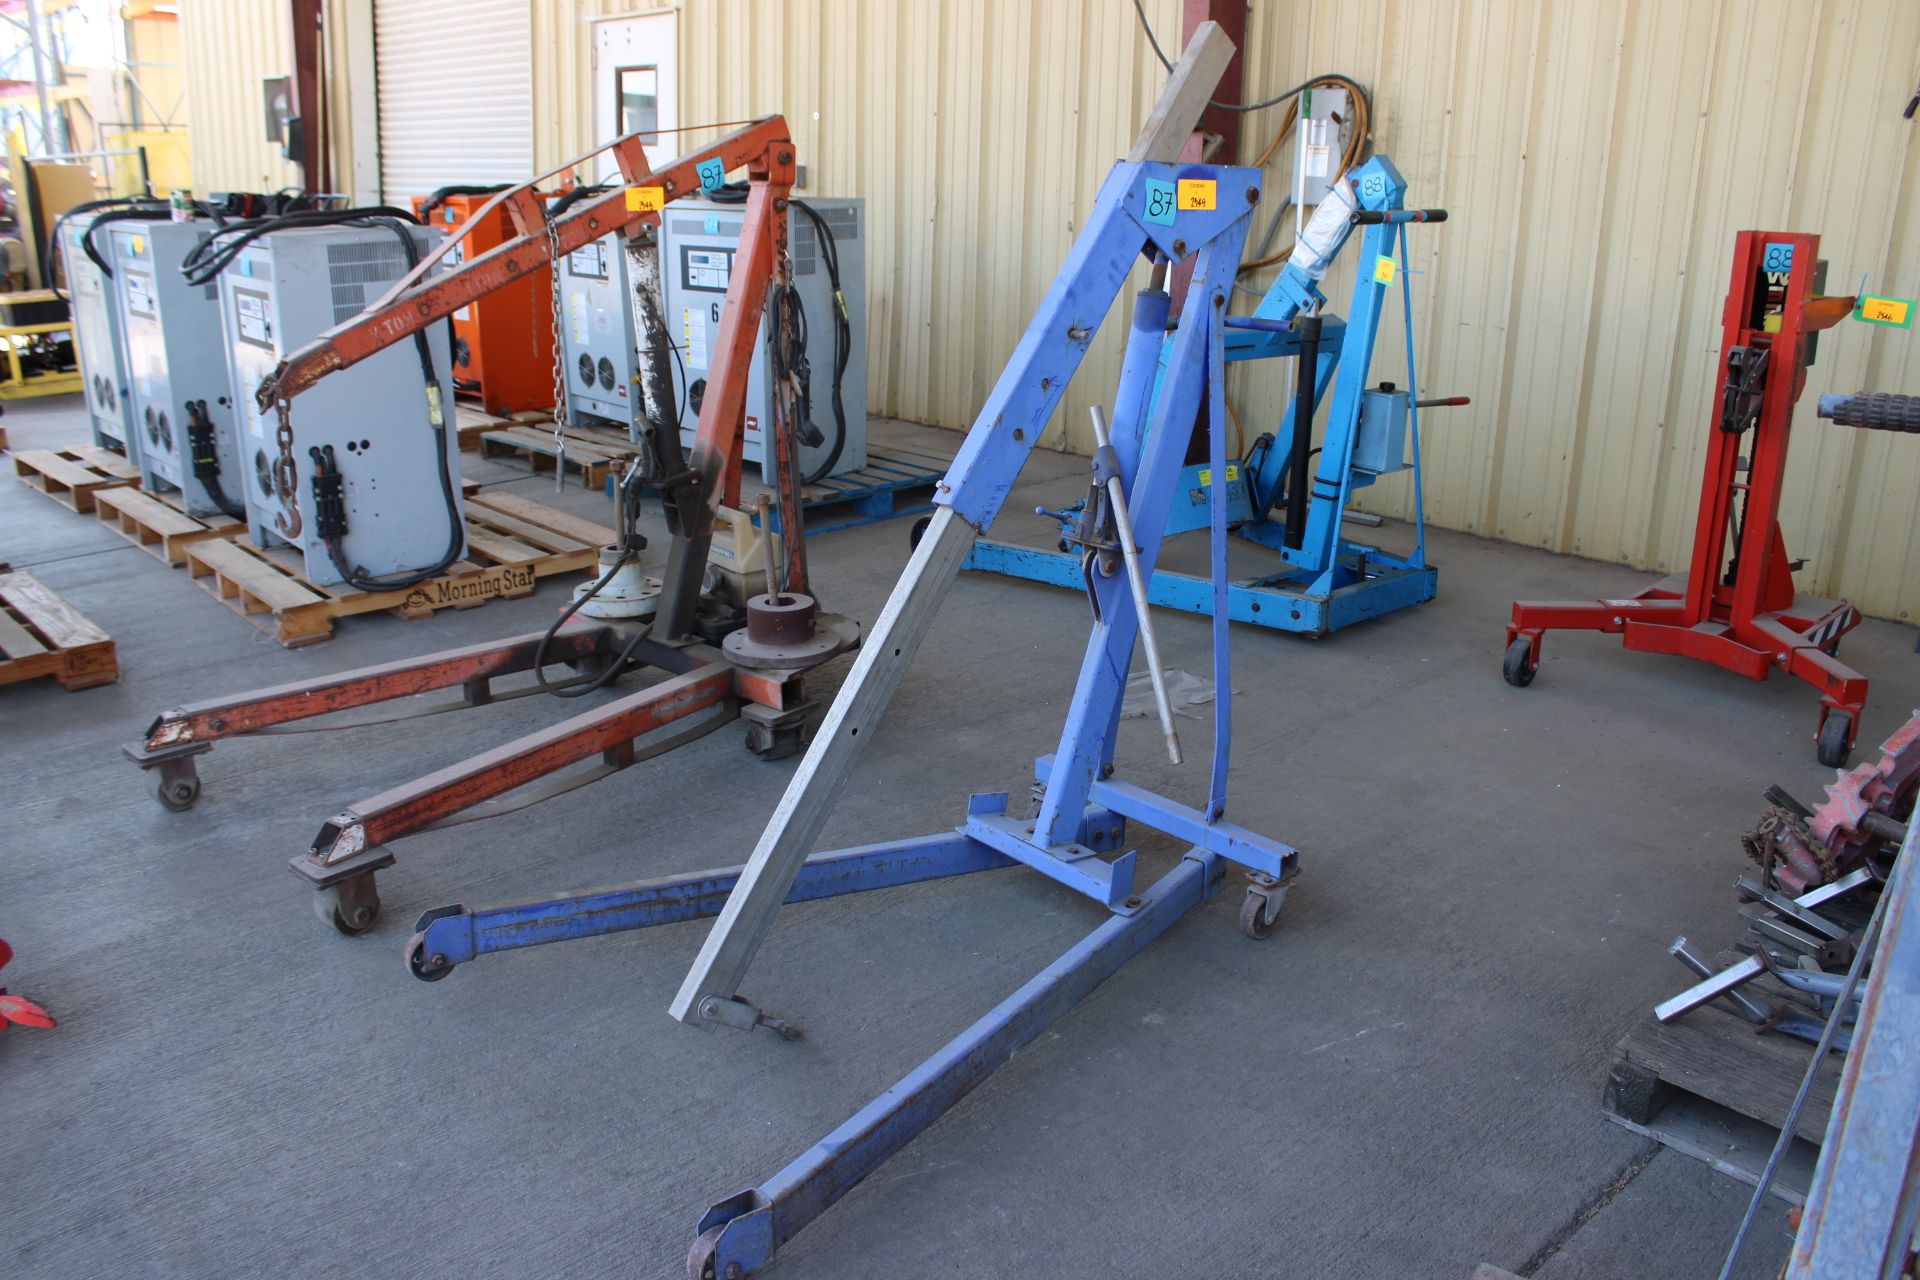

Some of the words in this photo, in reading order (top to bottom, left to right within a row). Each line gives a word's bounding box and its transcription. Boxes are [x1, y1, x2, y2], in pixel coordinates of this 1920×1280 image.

[701, 165, 721, 189] 87
[1365, 177, 1382, 196] 88
[1149, 188, 1173, 216] 87
[1767, 248, 1793, 269] 88
[711, 302, 719, 323] 6
[437, 576, 501, 602] Morning
[503, 565, 535, 590] Star
